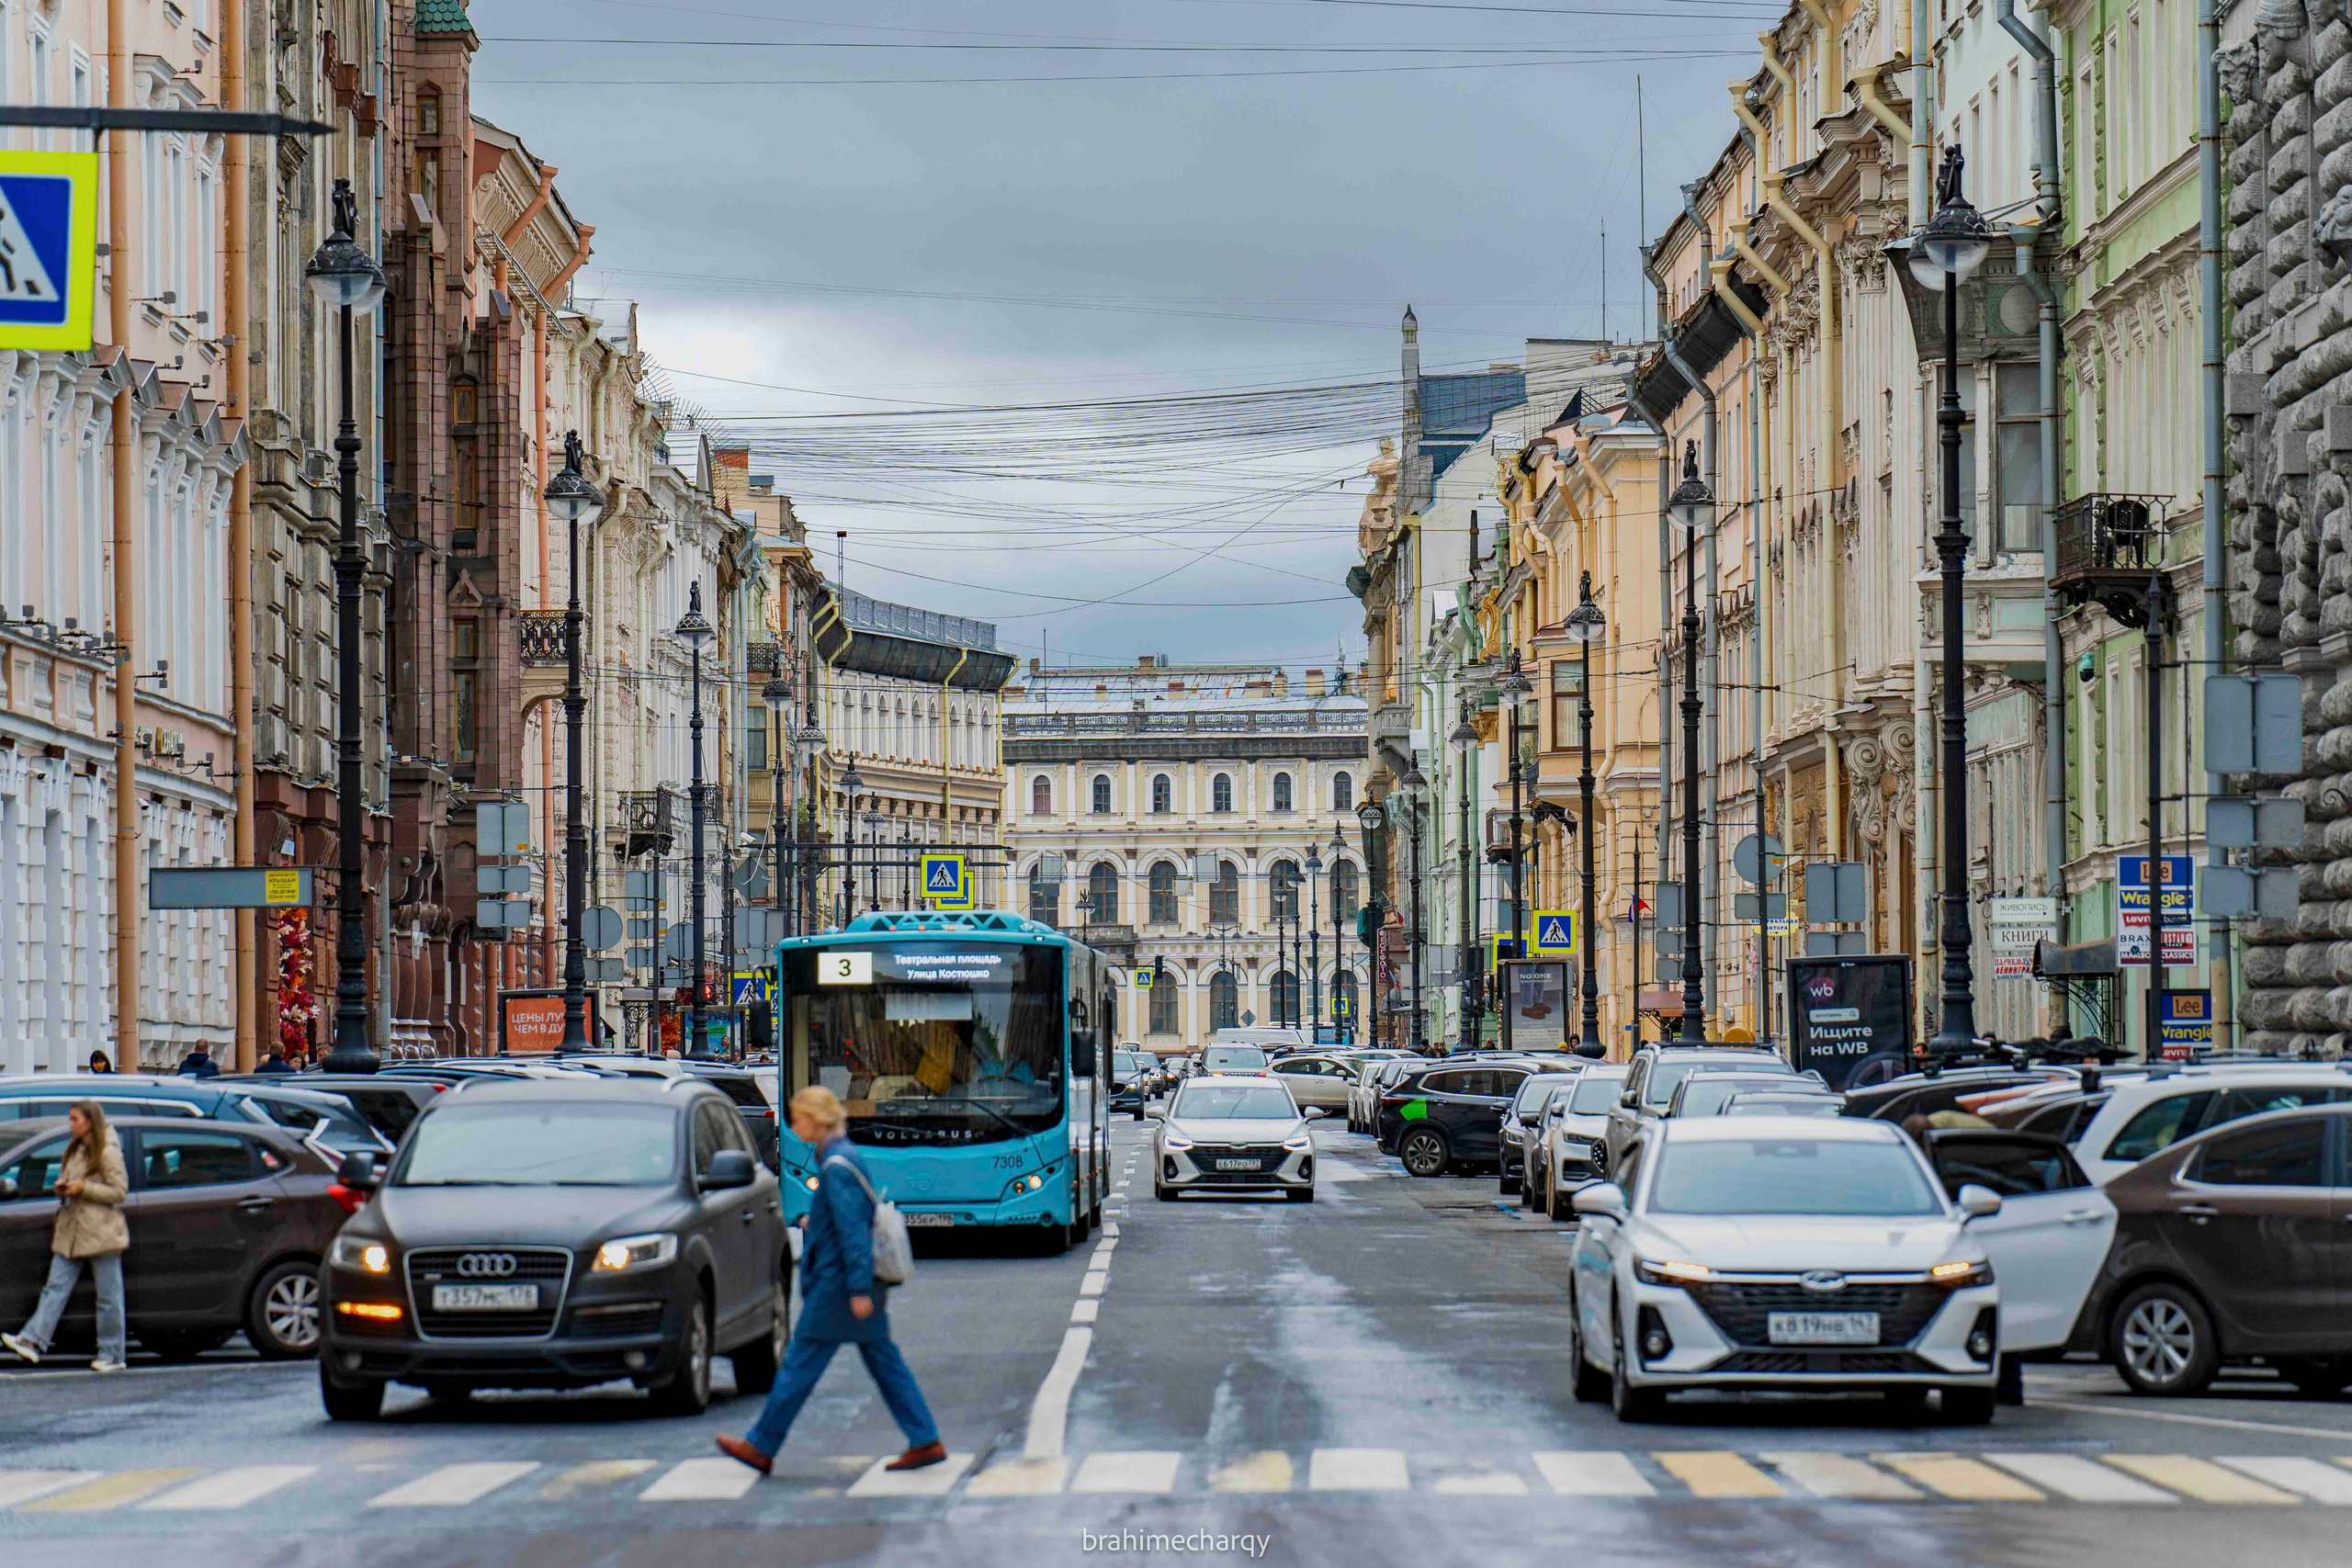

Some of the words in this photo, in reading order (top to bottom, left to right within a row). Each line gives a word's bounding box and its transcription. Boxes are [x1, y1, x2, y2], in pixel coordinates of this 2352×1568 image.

[2143, 864, 2168, 879] Le
[2121, 891, 2191, 908] Wragle
[1999, 903, 2049, 911] ЖИВОПИСЬ
[2001, 930, 2049, 942] КНИГИ
[2161, 933, 2193, 943] USTANG
[838, 959, 852, 976] 3
[895, 954, 956, 965] Театральная
[957, 955, 1001, 964] площадь
[907, 969, 936, 980] Улица
[939, 968, 990, 978] Костюшко
[1810, 982, 1834, 997] wb
[2175, 998, 2200, 1014] Lee
[512, 1013, 544, 1023] ЦЕНЫ
[514, 1024, 538, 1034] ЧЕМ
[540, 1024, 547, 1033] В
[1809, 1026, 1873, 1040] Ищите
[1810, 1045, 1834, 1055] на
[1837, 1041, 1869, 1055] WB
[992, 1155, 1024, 1168] 7308
